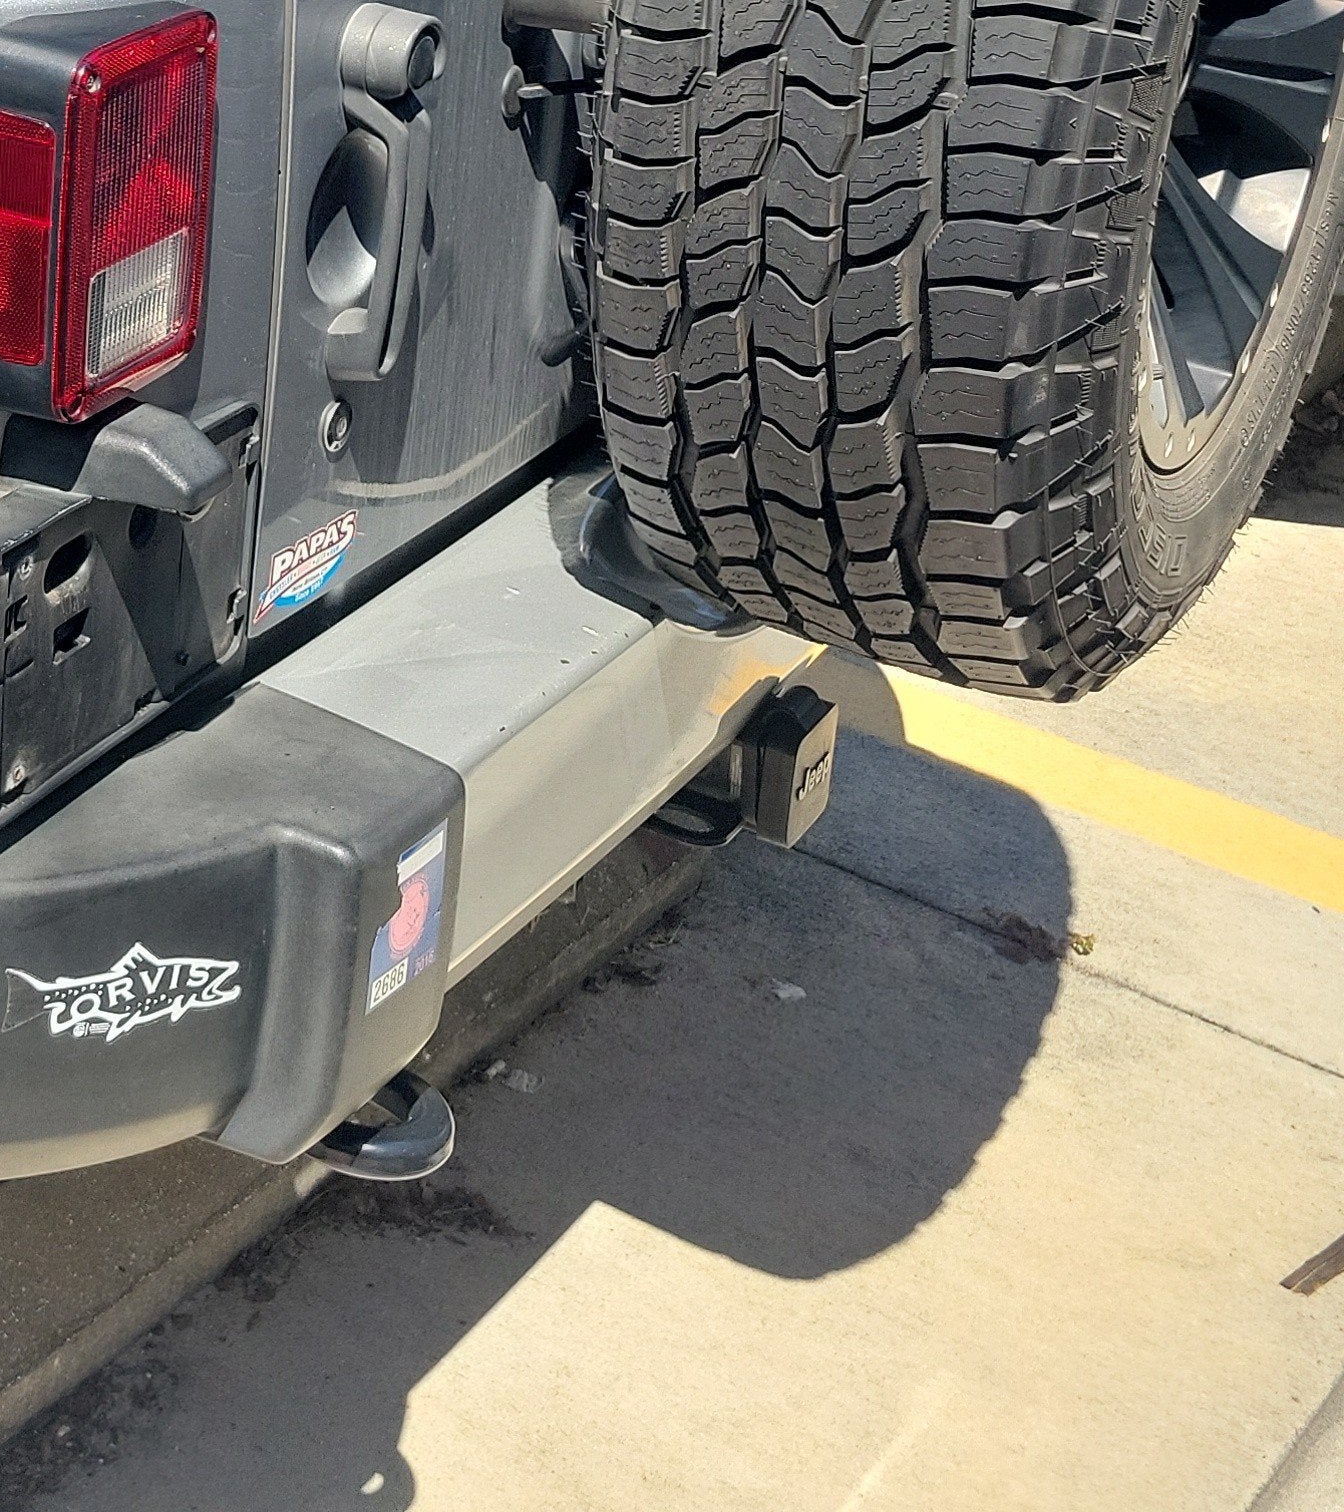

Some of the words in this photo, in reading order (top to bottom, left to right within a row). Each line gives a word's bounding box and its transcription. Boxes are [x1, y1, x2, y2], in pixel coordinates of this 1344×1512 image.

[270, 511, 355, 585] PAPA'S
[797, 751, 831, 801] Jeep
[69, 964, 210, 1020] ORVIS
[373, 962, 405, 1003] 2686
